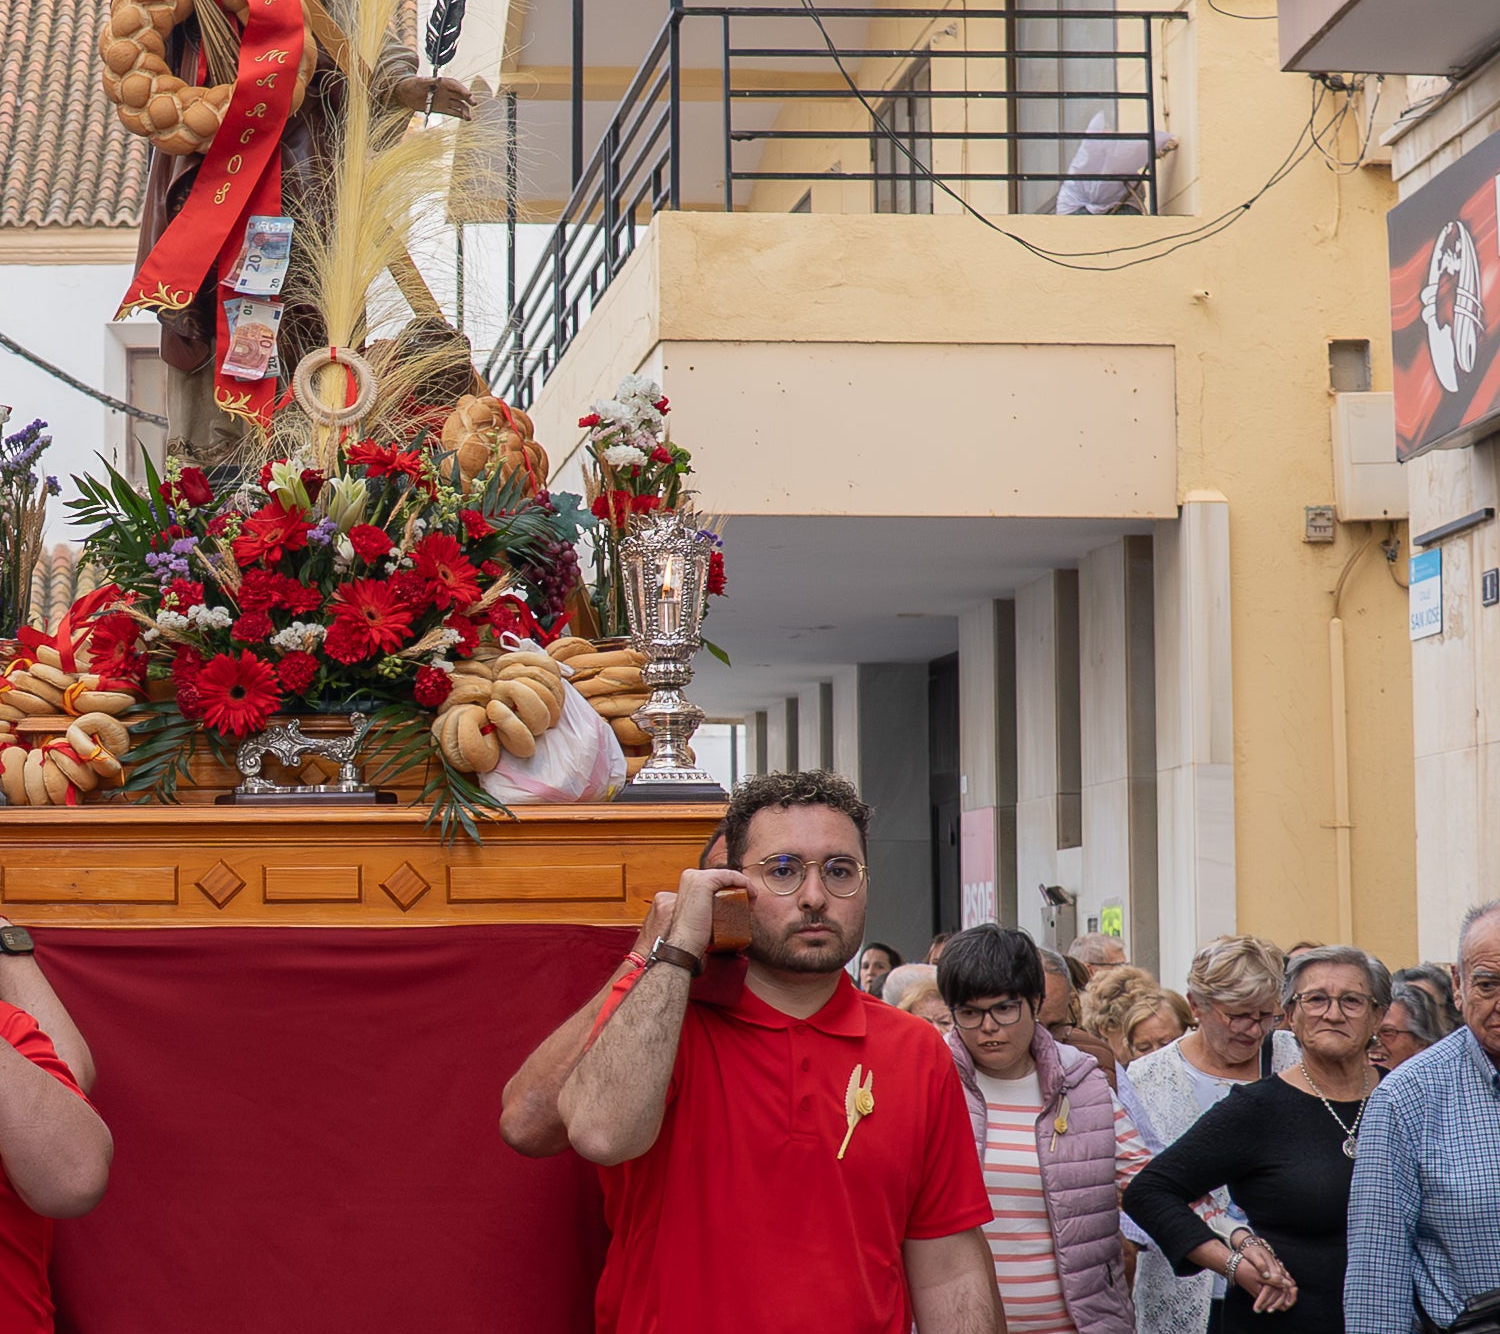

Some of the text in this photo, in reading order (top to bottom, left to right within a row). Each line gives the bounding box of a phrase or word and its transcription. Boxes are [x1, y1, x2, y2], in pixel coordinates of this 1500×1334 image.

[213, 49, 289, 205] MARCOS
[246, 254, 262, 272] 20
[269, 278, 280, 289] 20
[243, 304, 253, 316] 10
[260, 333, 274, 349] 10
[963, 880, 994, 931] PSOE
